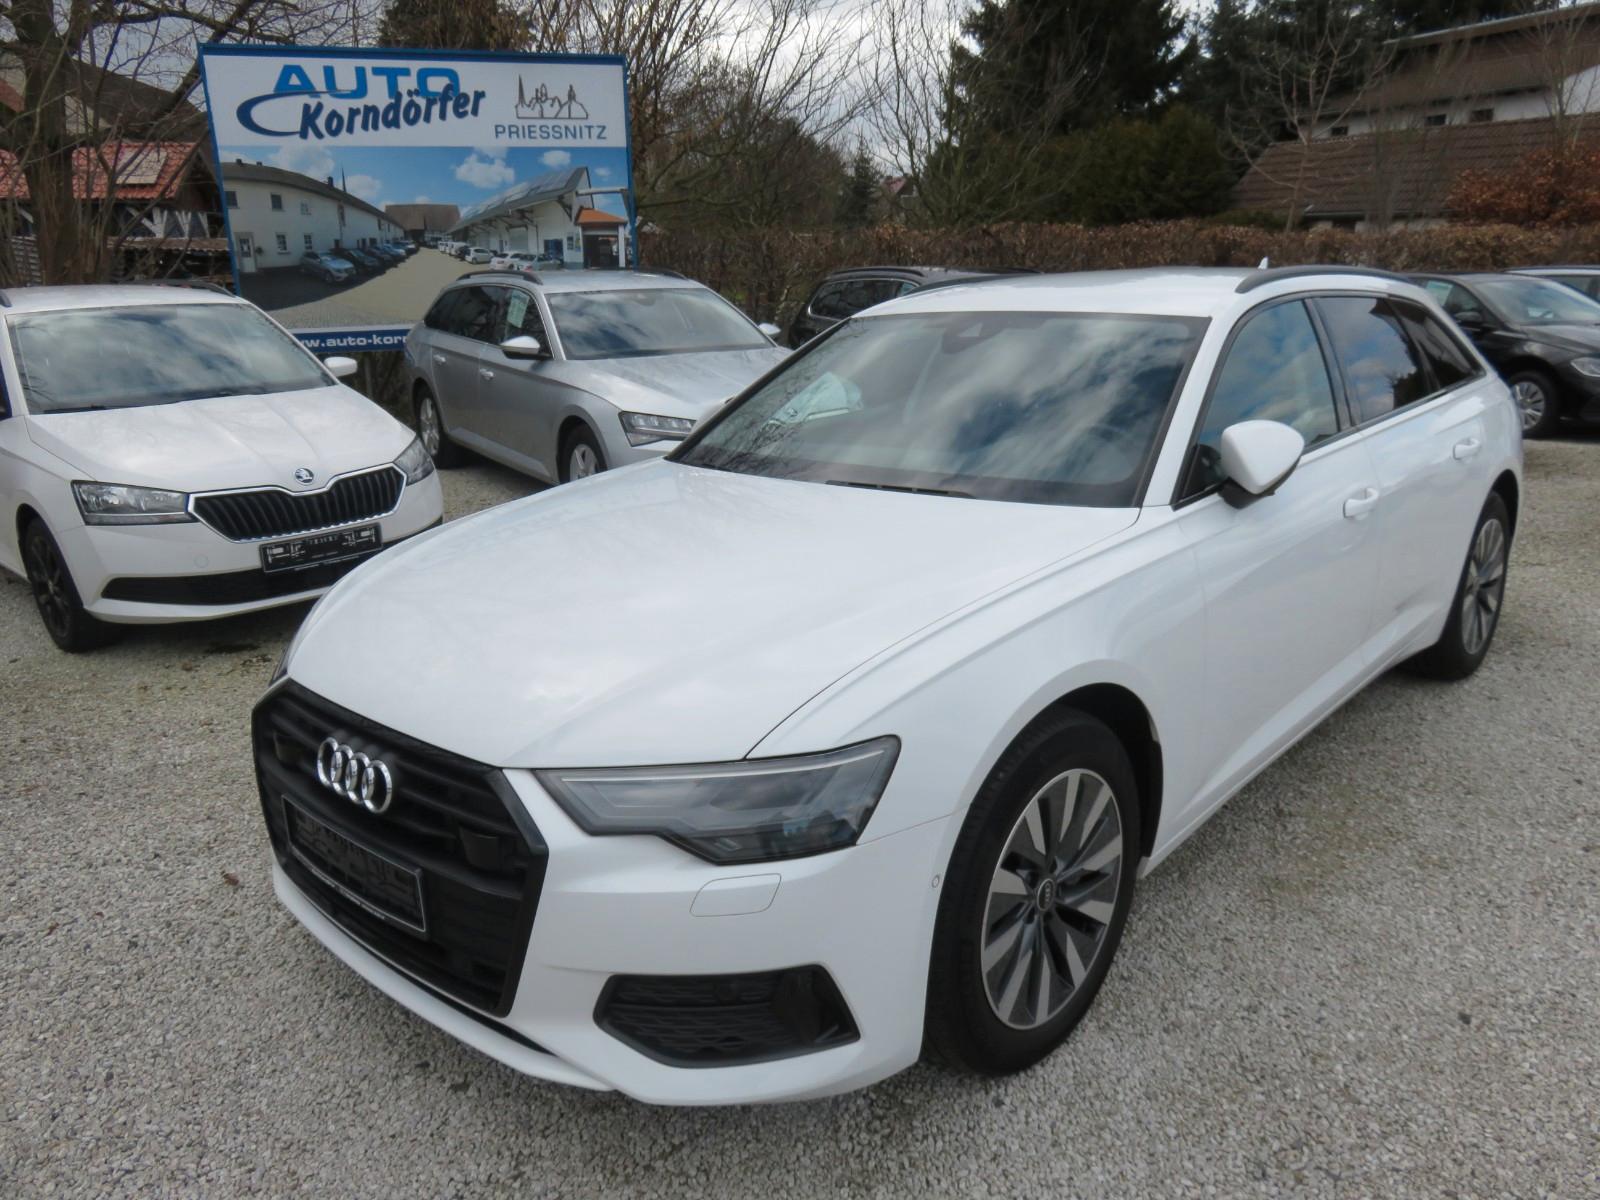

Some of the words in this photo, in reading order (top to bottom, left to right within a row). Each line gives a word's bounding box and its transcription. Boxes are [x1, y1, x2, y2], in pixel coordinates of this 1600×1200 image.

[273, 64, 460, 98] AUTO
[300, 84, 486, 140] Korndörfer
[494, 124, 607, 140] PRIESSNITZ
[301, 334, 407, 348] w.auto-kor
